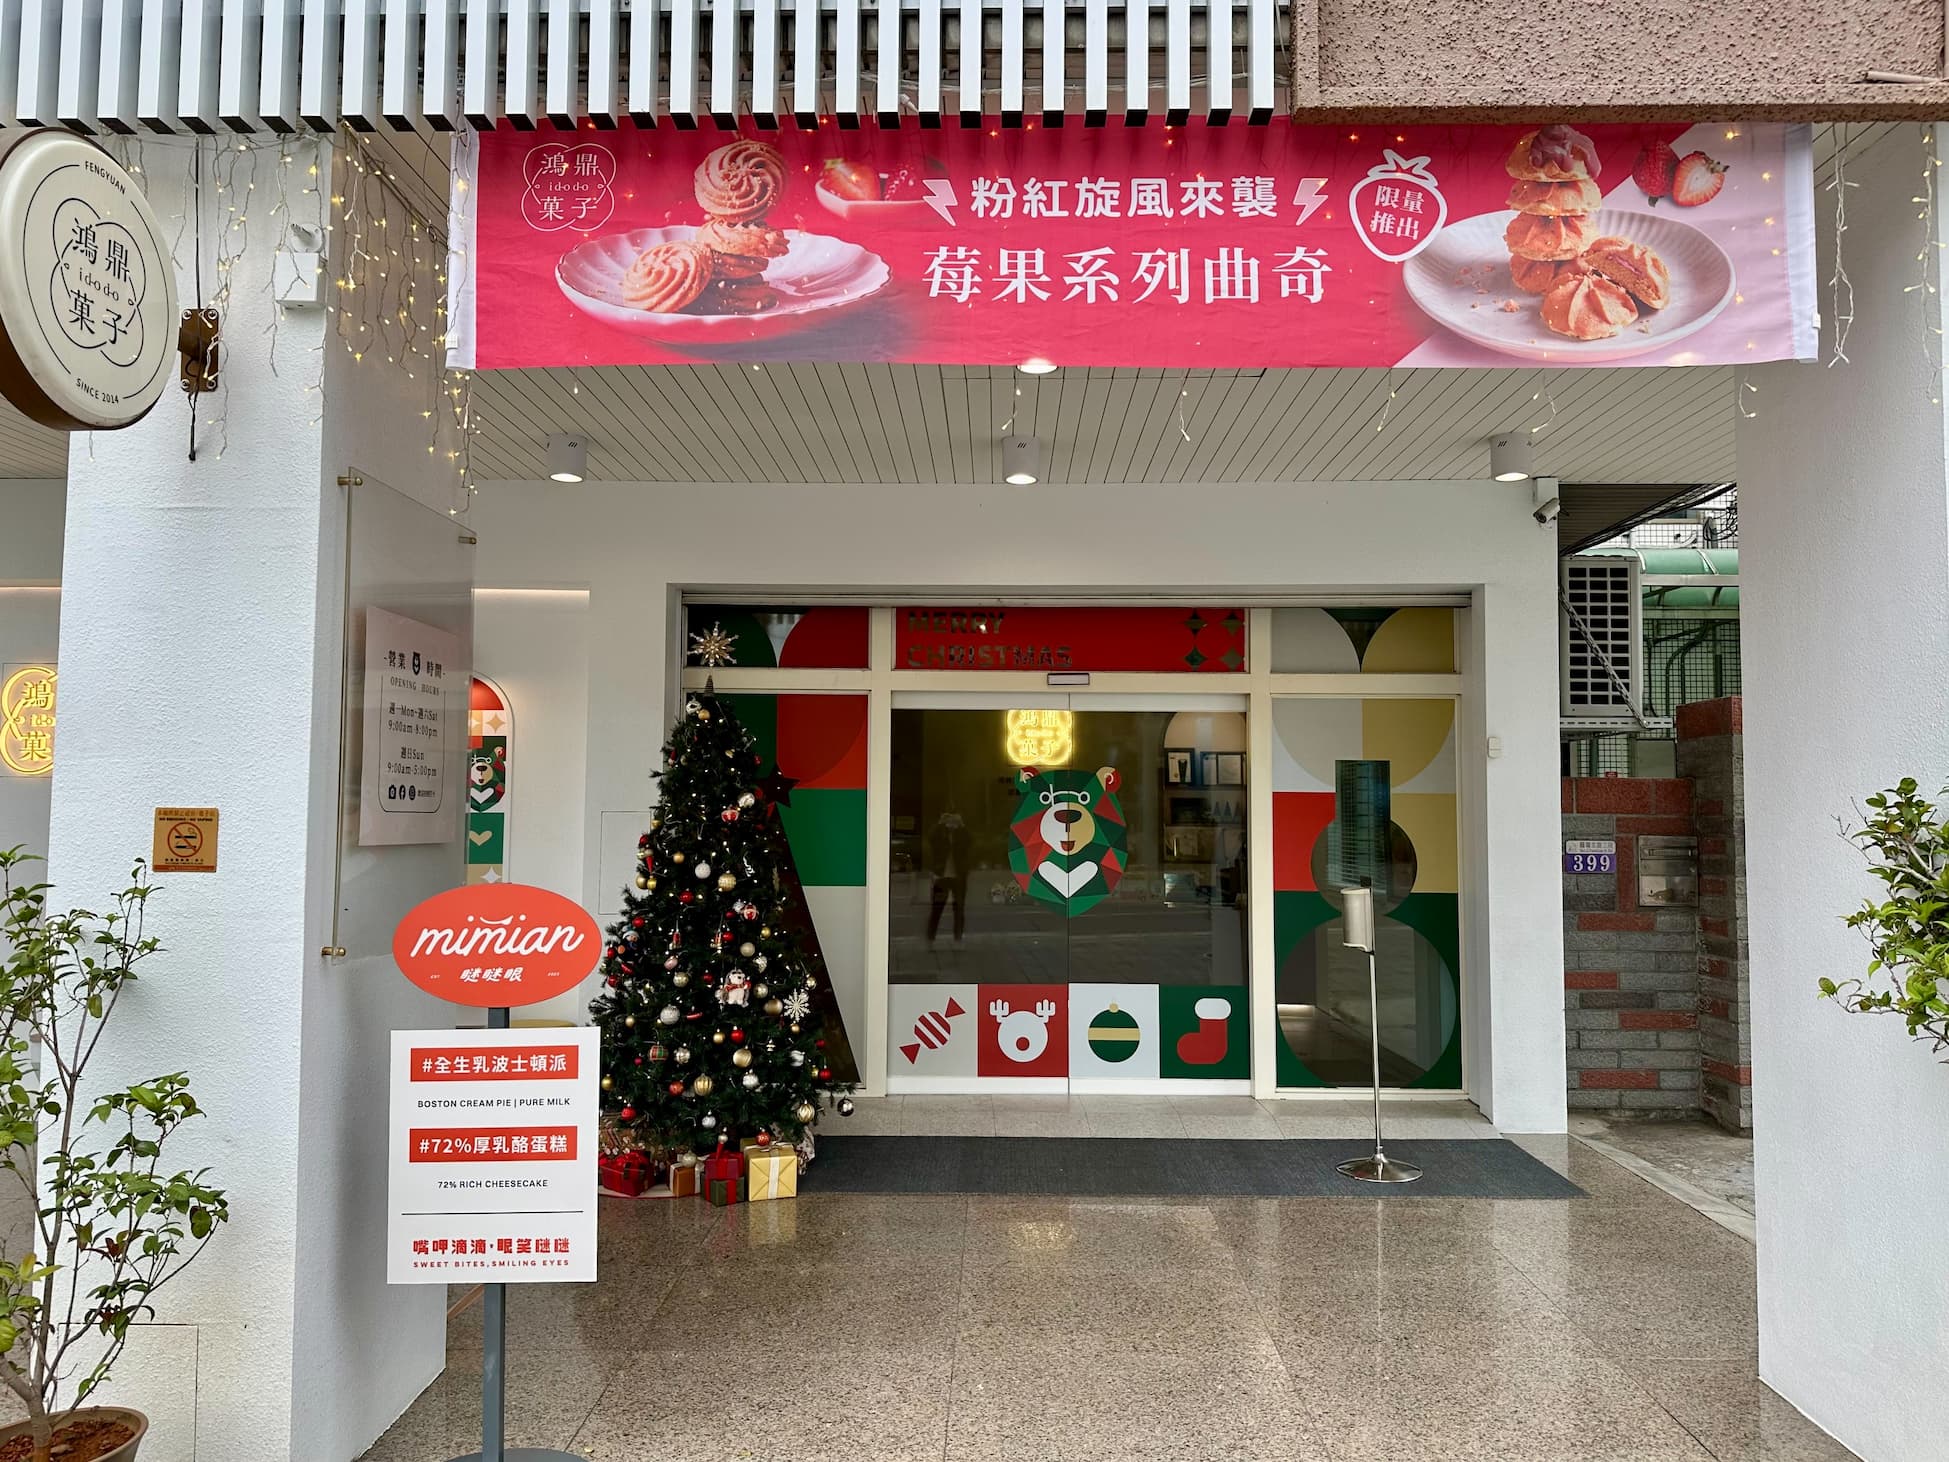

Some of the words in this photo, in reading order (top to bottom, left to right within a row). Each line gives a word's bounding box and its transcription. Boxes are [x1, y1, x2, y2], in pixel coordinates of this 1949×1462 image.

[84, 160, 126, 196] FENGYUAN
[541, 152, 599, 177] 鴻鼎
[538, 196, 598, 221] 菓子
[970, 176, 1278, 218] 粉紅旋風來襲
[1375, 184, 1425, 214] 限量
[1369, 210, 1419, 240] 推出
[71, 217, 130, 283] 鴻鼎
[921, 245, 1333, 305] 莓果系列曲奇
[68, 289, 128, 345] 菓子
[76, 378, 100, 400] SINCE
[101, 392, 119, 404] 2014
[908, 610, 1006, 634] MERRY
[907, 645, 1073, 668] CHRISTMAS
[21, 680, 50, 709] 鴻
[19, 731, 47, 761] 菓
[1573, 855, 1611, 872] 399
[410, 914, 585, 957] mimian
[422, 1054, 567, 1074] #全生乳波士頓派
[417, 1099, 457, 1108] BOSTON
[459, 1099, 494, 1107] CREAM
[496, 1099, 512, 1107] PIE
[519, 1098, 544, 1106] PURE
[547, 1097, 571, 1106] MILK
[419, 1135, 568, 1154] #72%厚乳酪蛋糕
[438, 1181, 457, 1189] 72%
[459, 1180, 482, 1188] RICH
[485, 1179, 549, 1188] CHEESECAKE
